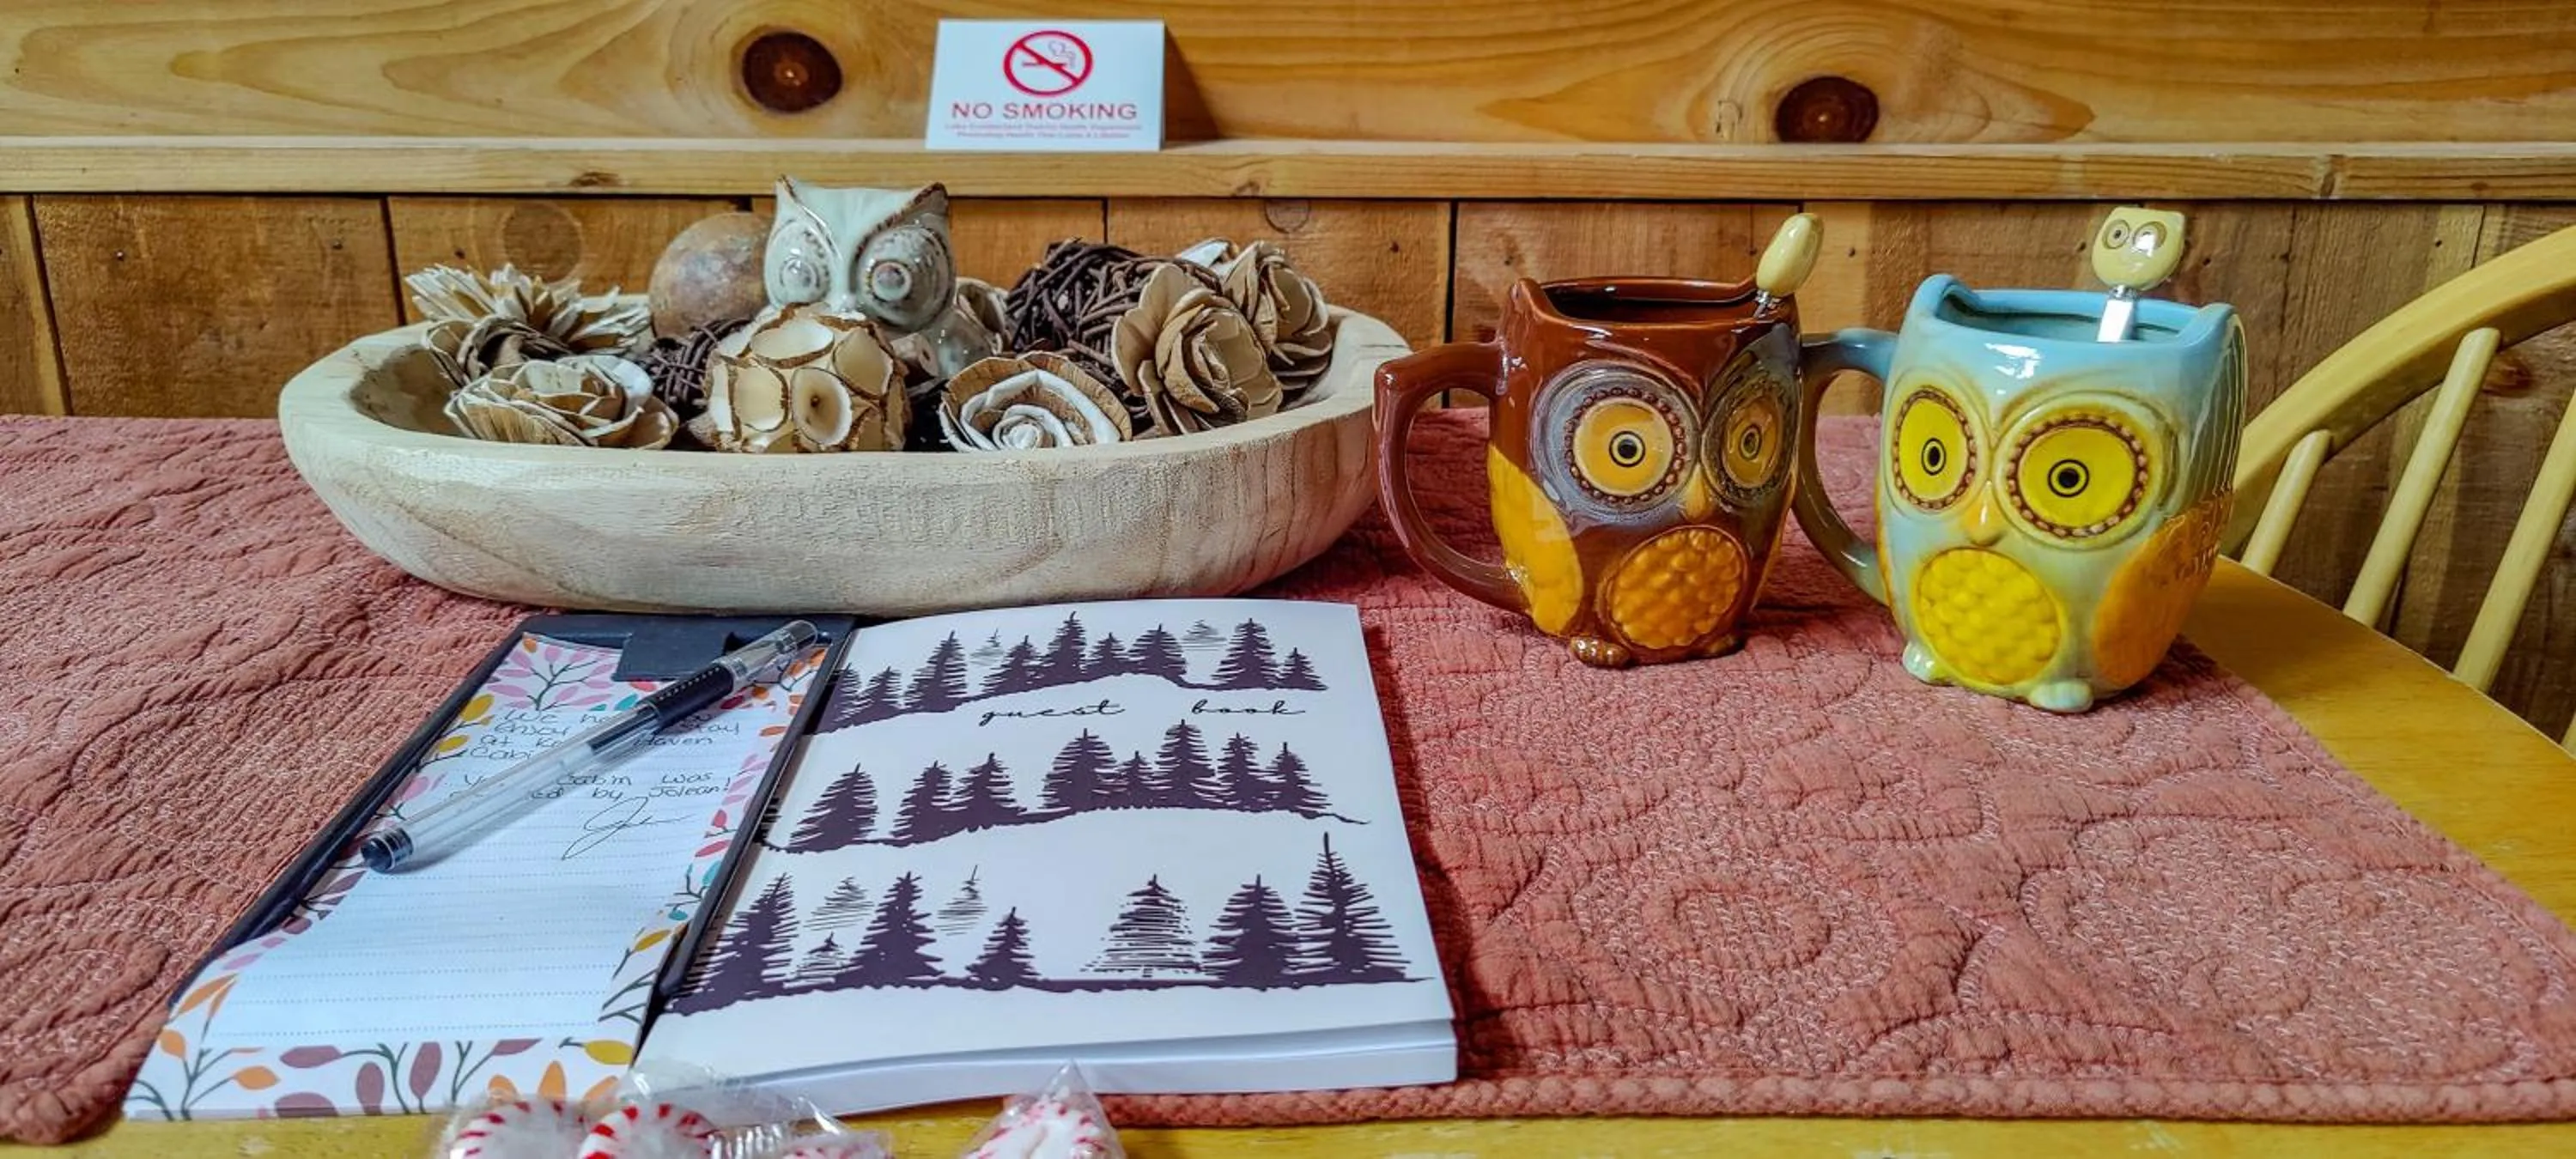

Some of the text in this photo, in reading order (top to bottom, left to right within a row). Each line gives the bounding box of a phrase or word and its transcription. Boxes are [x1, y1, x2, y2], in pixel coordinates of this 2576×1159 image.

[951, 102, 1138, 119] NO SMOKING
[978, 699, 1306, 726] guest book
[592, 786, 623, 801] by
